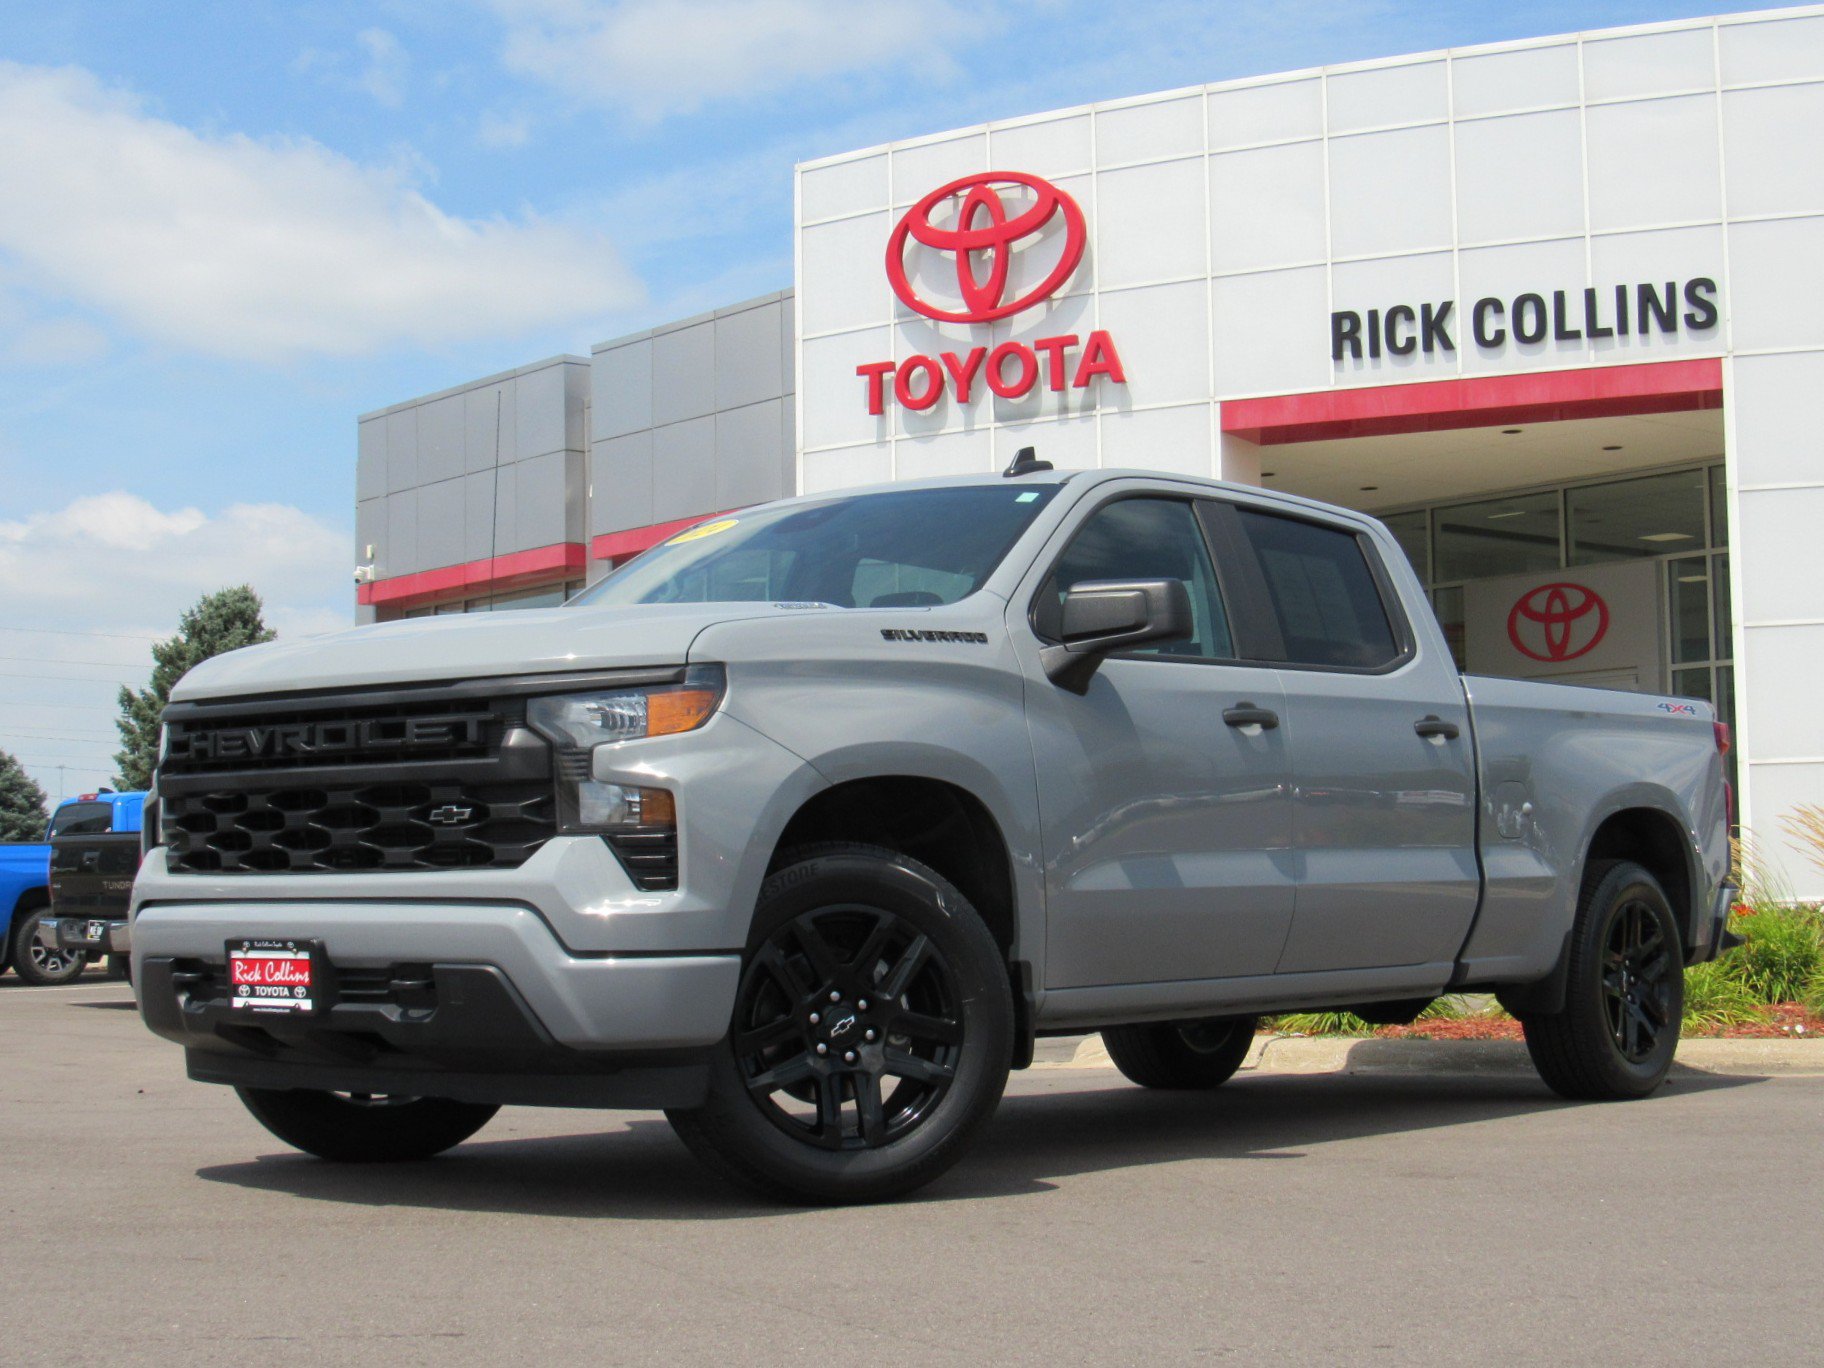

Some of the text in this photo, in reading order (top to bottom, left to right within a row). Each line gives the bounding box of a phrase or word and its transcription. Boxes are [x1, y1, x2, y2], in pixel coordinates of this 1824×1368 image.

[1331, 277, 1718, 361] RICK COLLINS
[856, 330, 1127, 415] TOYOTA
[880, 629, 989, 644] SILVERADO
[169, 713, 496, 760] CHEVROLET
[235, 961, 310, 983] Rick Collins
[255, 986, 290, 997] TOYOTA
